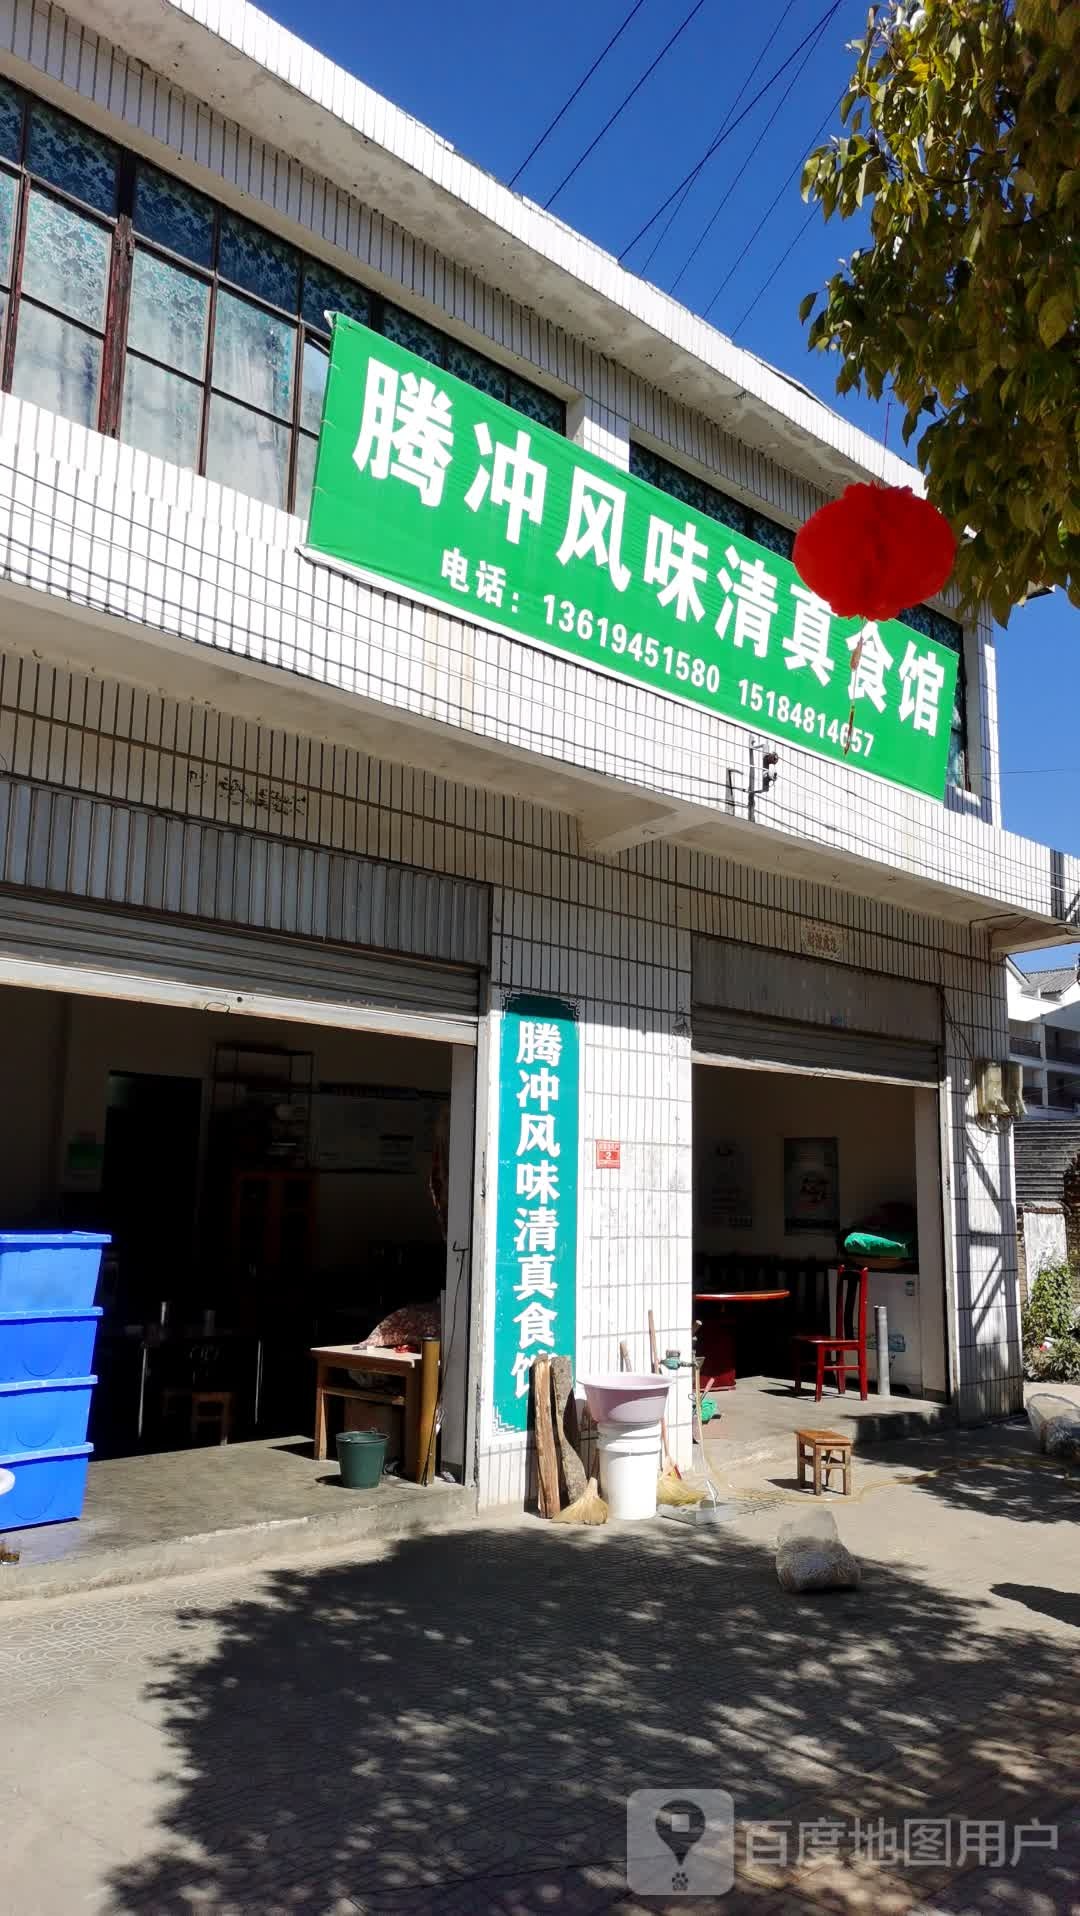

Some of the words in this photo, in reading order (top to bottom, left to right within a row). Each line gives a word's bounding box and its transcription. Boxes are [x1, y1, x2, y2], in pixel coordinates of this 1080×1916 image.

[352, 356, 946, 737] 腾冲风味清真食馆
[543, 594, 721, 693] 13619451580
[738, 679, 875, 757] 15184814657
